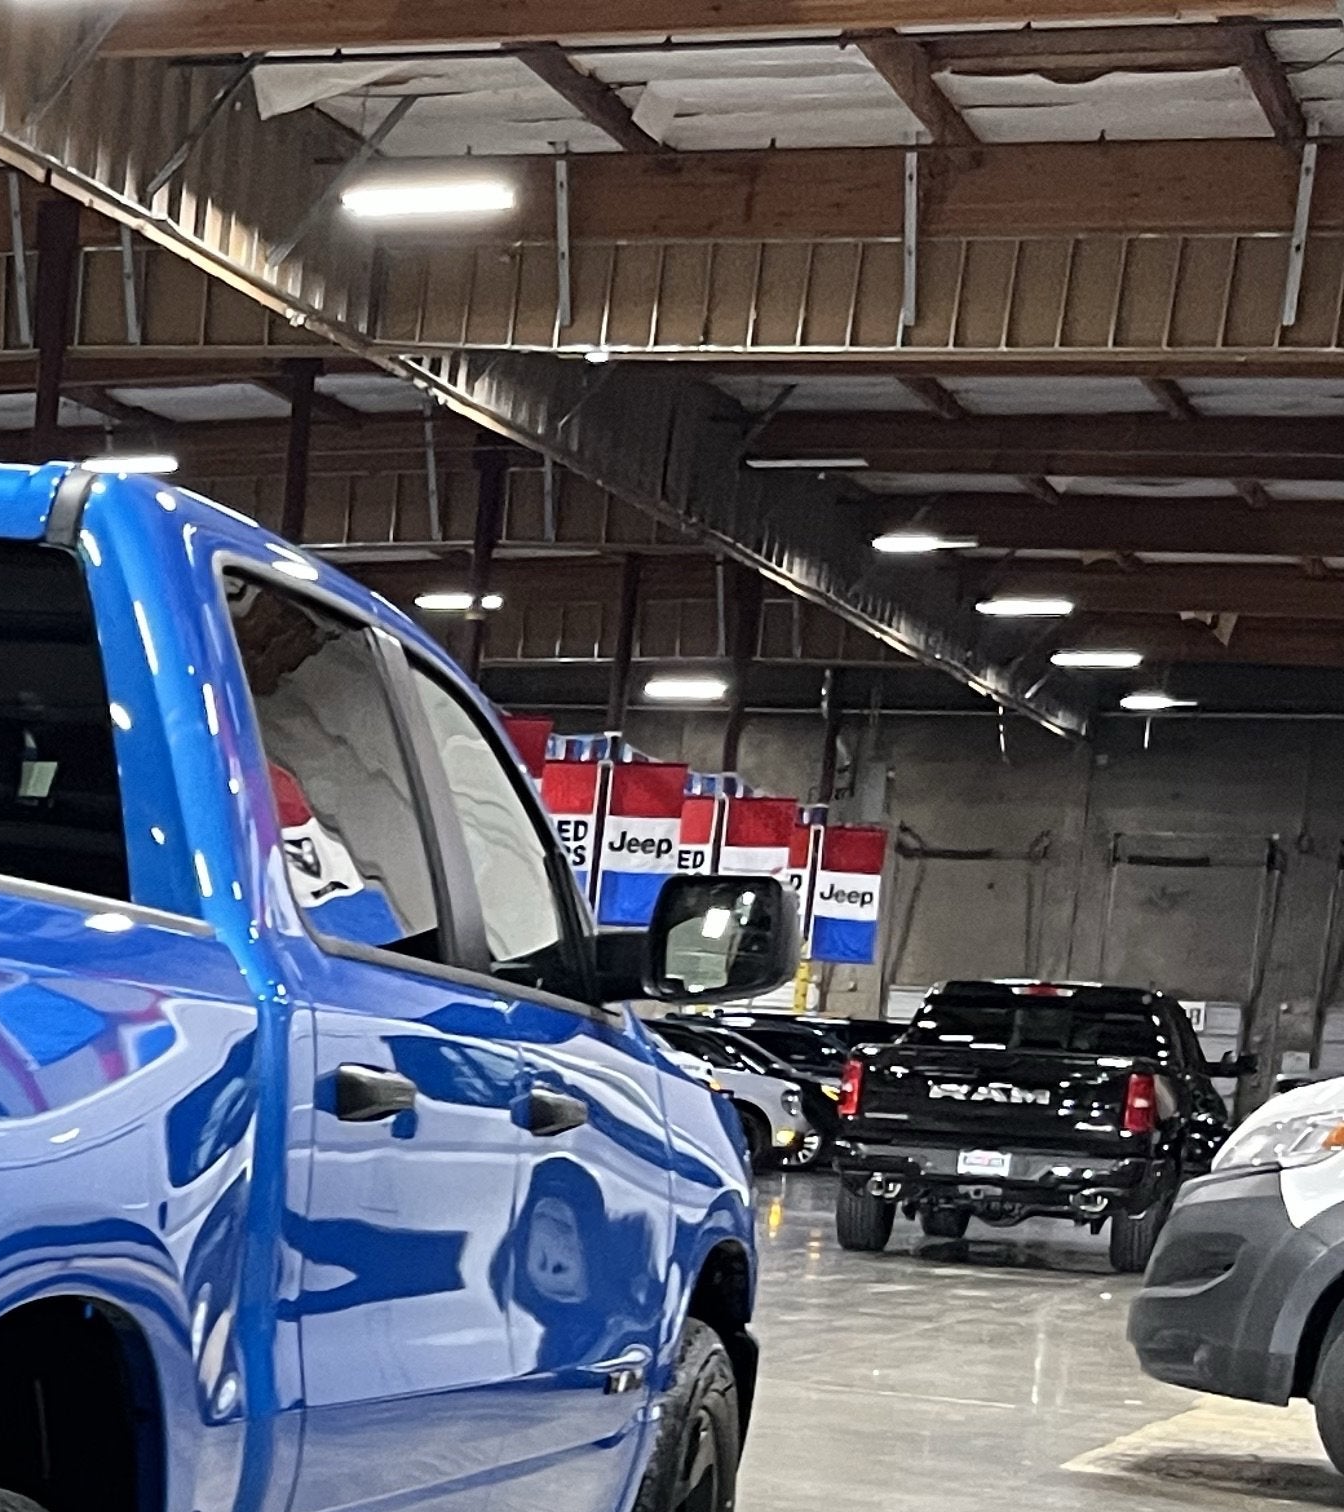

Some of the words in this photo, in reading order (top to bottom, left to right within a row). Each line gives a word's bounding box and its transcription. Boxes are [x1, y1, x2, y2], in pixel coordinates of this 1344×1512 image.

[557, 820, 588, 842] ED
[608, 831, 673, 859] Jeep
[677, 850, 705, 869] ED
[819, 884, 874, 908] Jeep
